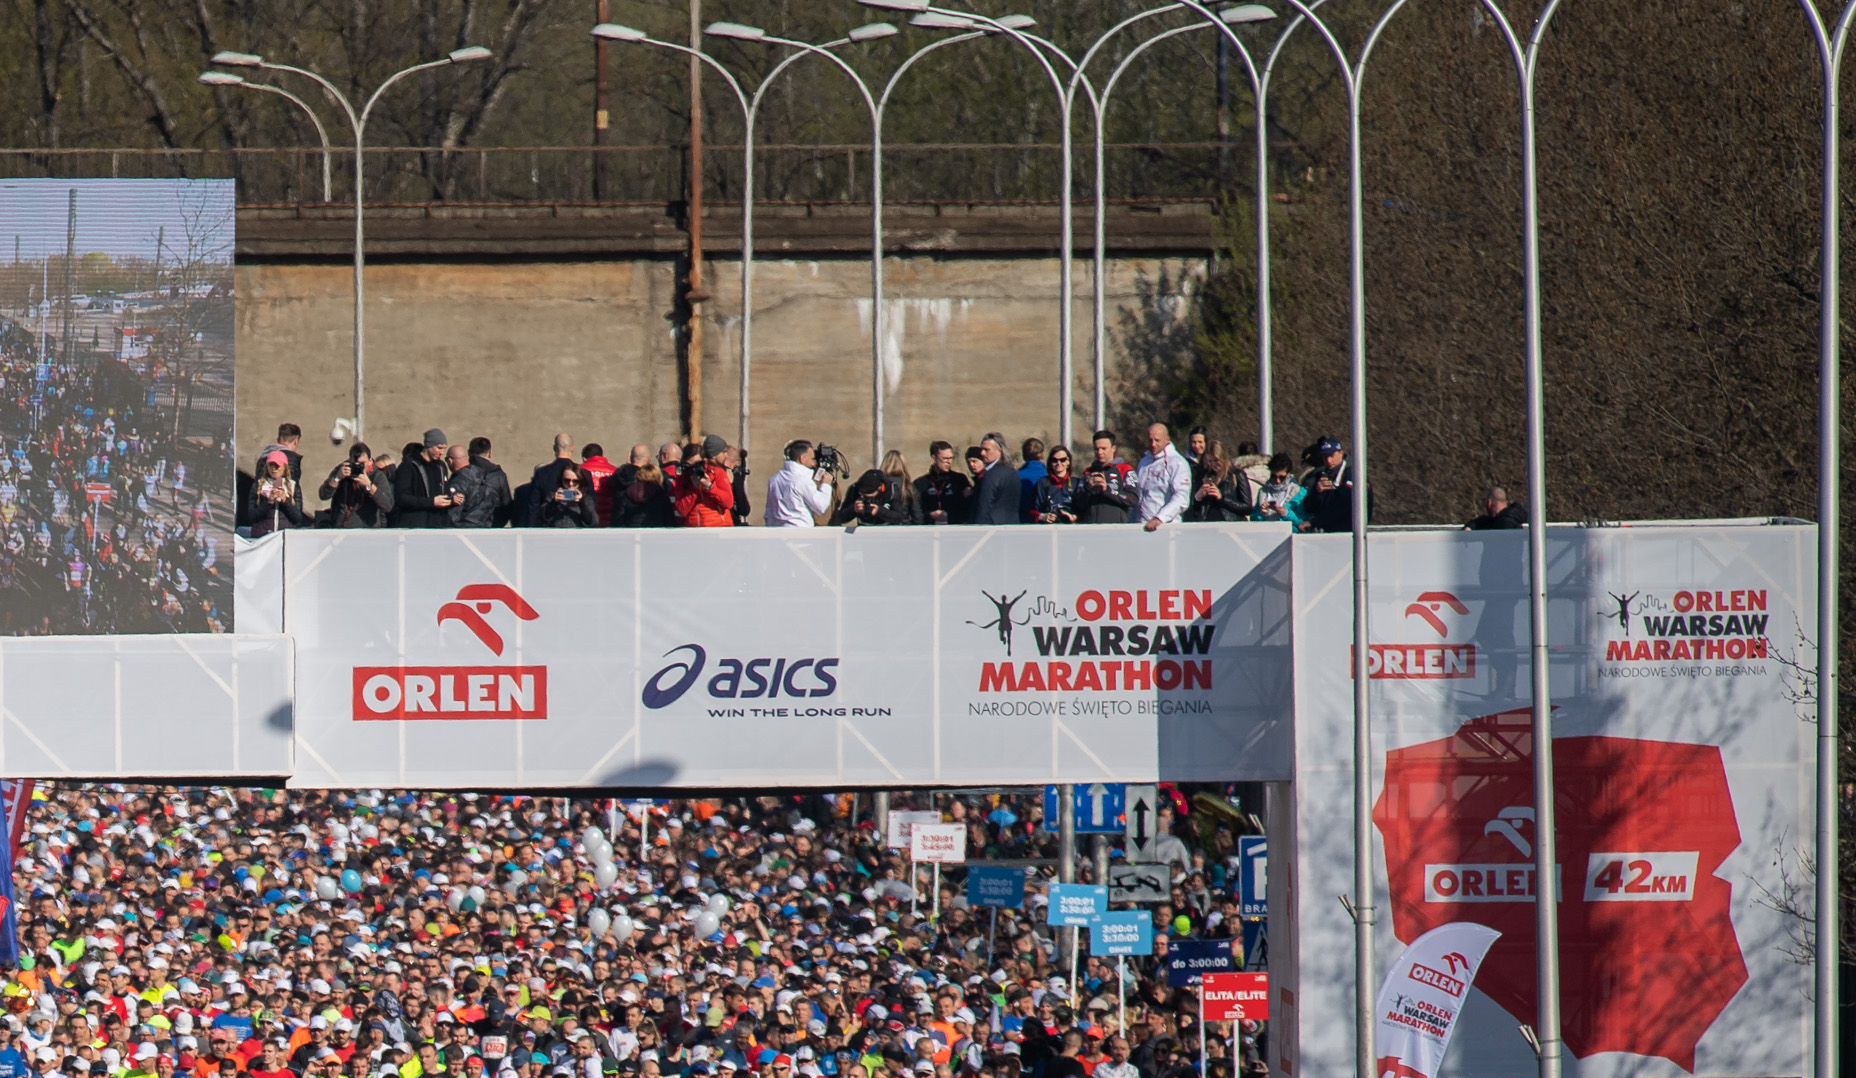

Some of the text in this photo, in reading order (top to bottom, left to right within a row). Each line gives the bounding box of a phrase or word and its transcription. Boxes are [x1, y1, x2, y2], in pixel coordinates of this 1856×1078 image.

[1076, 589, 1212, 622] ORLEN
[1673, 590, 1767, 613] ORLEN
[1644, 614, 1769, 637] WARSAW
[1032, 625, 1215, 656] WARSAW
[1606, 638, 1767, 661] MARATHON
[979, 660, 1212, 692] MARATHON
[1598, 667, 1666, 678] NARODOWE
[1715, 666, 1767, 677] BIEGANIA
[362, 673, 535, 713] ORLEN
[708, 708, 891, 717] WIN THE LONG RUN
[969, 697, 1212, 718] NARODOWE ŚWIĘTO BIEGANIA
[1433, 869, 1536, 896] ORLE
[1102, 924, 1138, 934] 3:00:01
[1102, 933, 1139, 943] 3:30:00
[1172, 958, 1228, 968] do 3:00:00
[1412, 965, 1460, 996] ORLEN
[1204, 991, 1266, 1000] ELITA/ELITE
[1404, 1005, 1449, 1029] WARSAW
[1417, 1000, 1453, 1021] ORLEN
[1386, 1011, 1445, 1039] MARATHON
